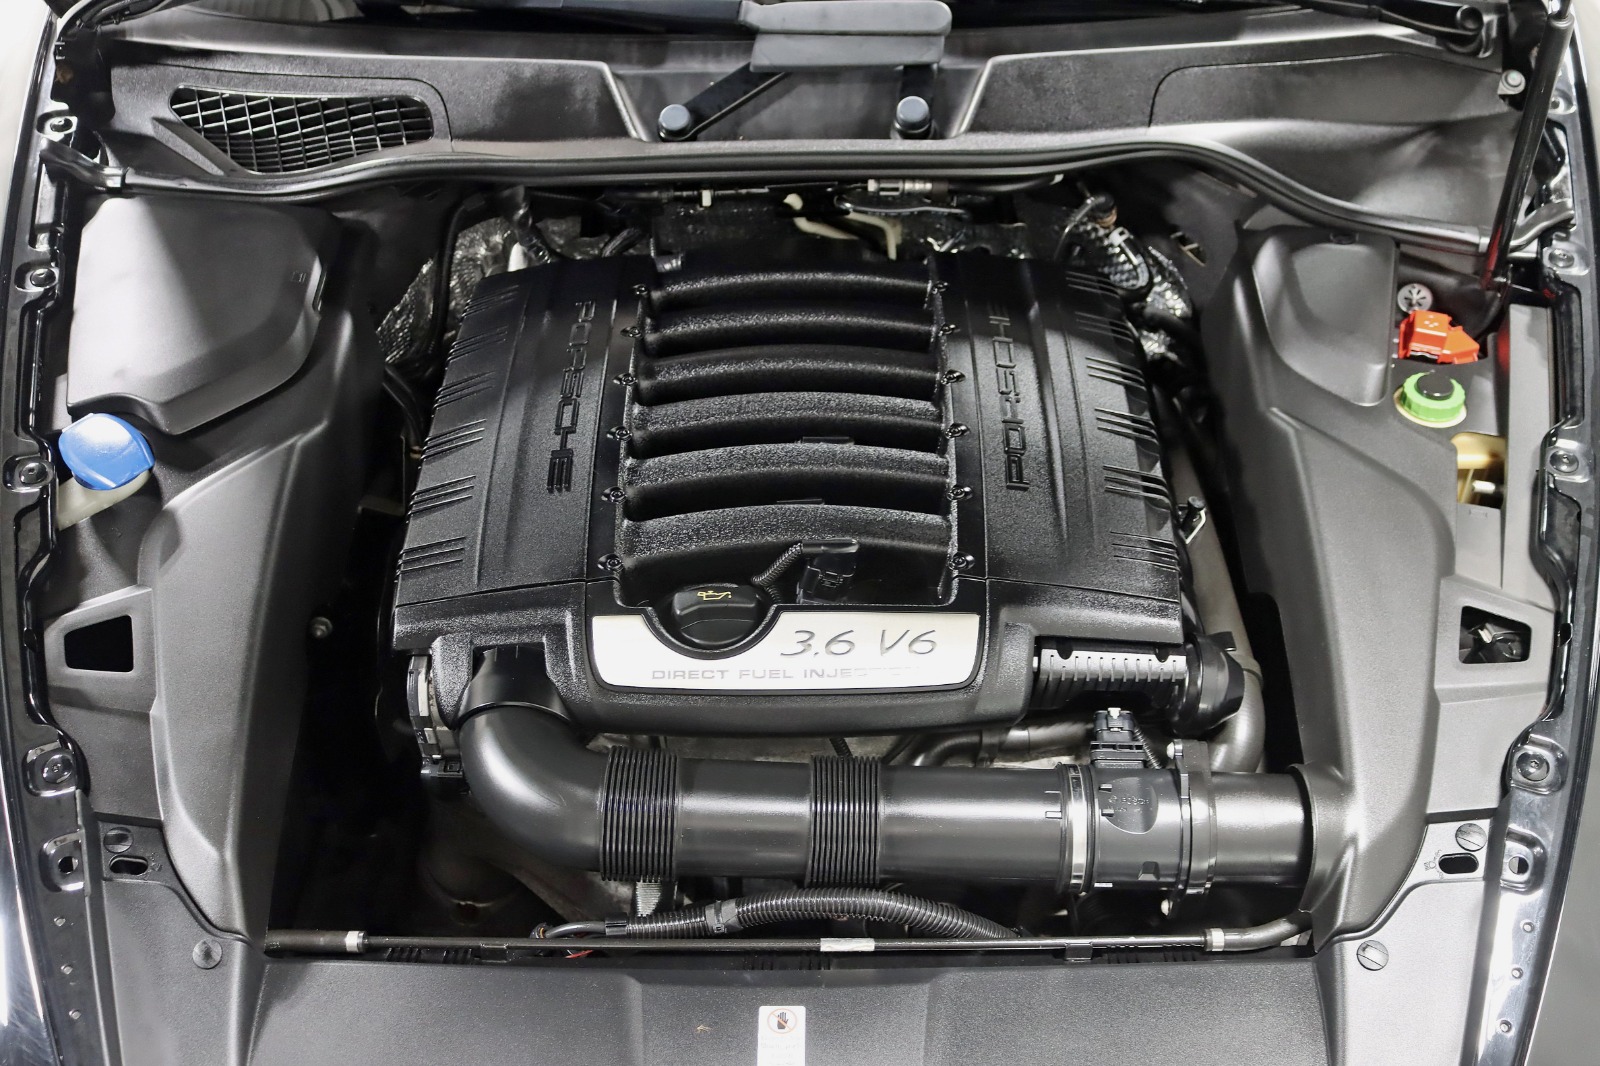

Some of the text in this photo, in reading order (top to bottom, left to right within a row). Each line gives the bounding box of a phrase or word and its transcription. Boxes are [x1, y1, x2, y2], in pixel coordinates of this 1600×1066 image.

[547, 300, 597, 494] PORSCHE
[987, 303, 1030, 491] PORSCHE
[651, 669, 730, 680] DIRECT
[738, 668, 794, 680] FUEL
[780, 629, 937, 657] 3.6 V6
